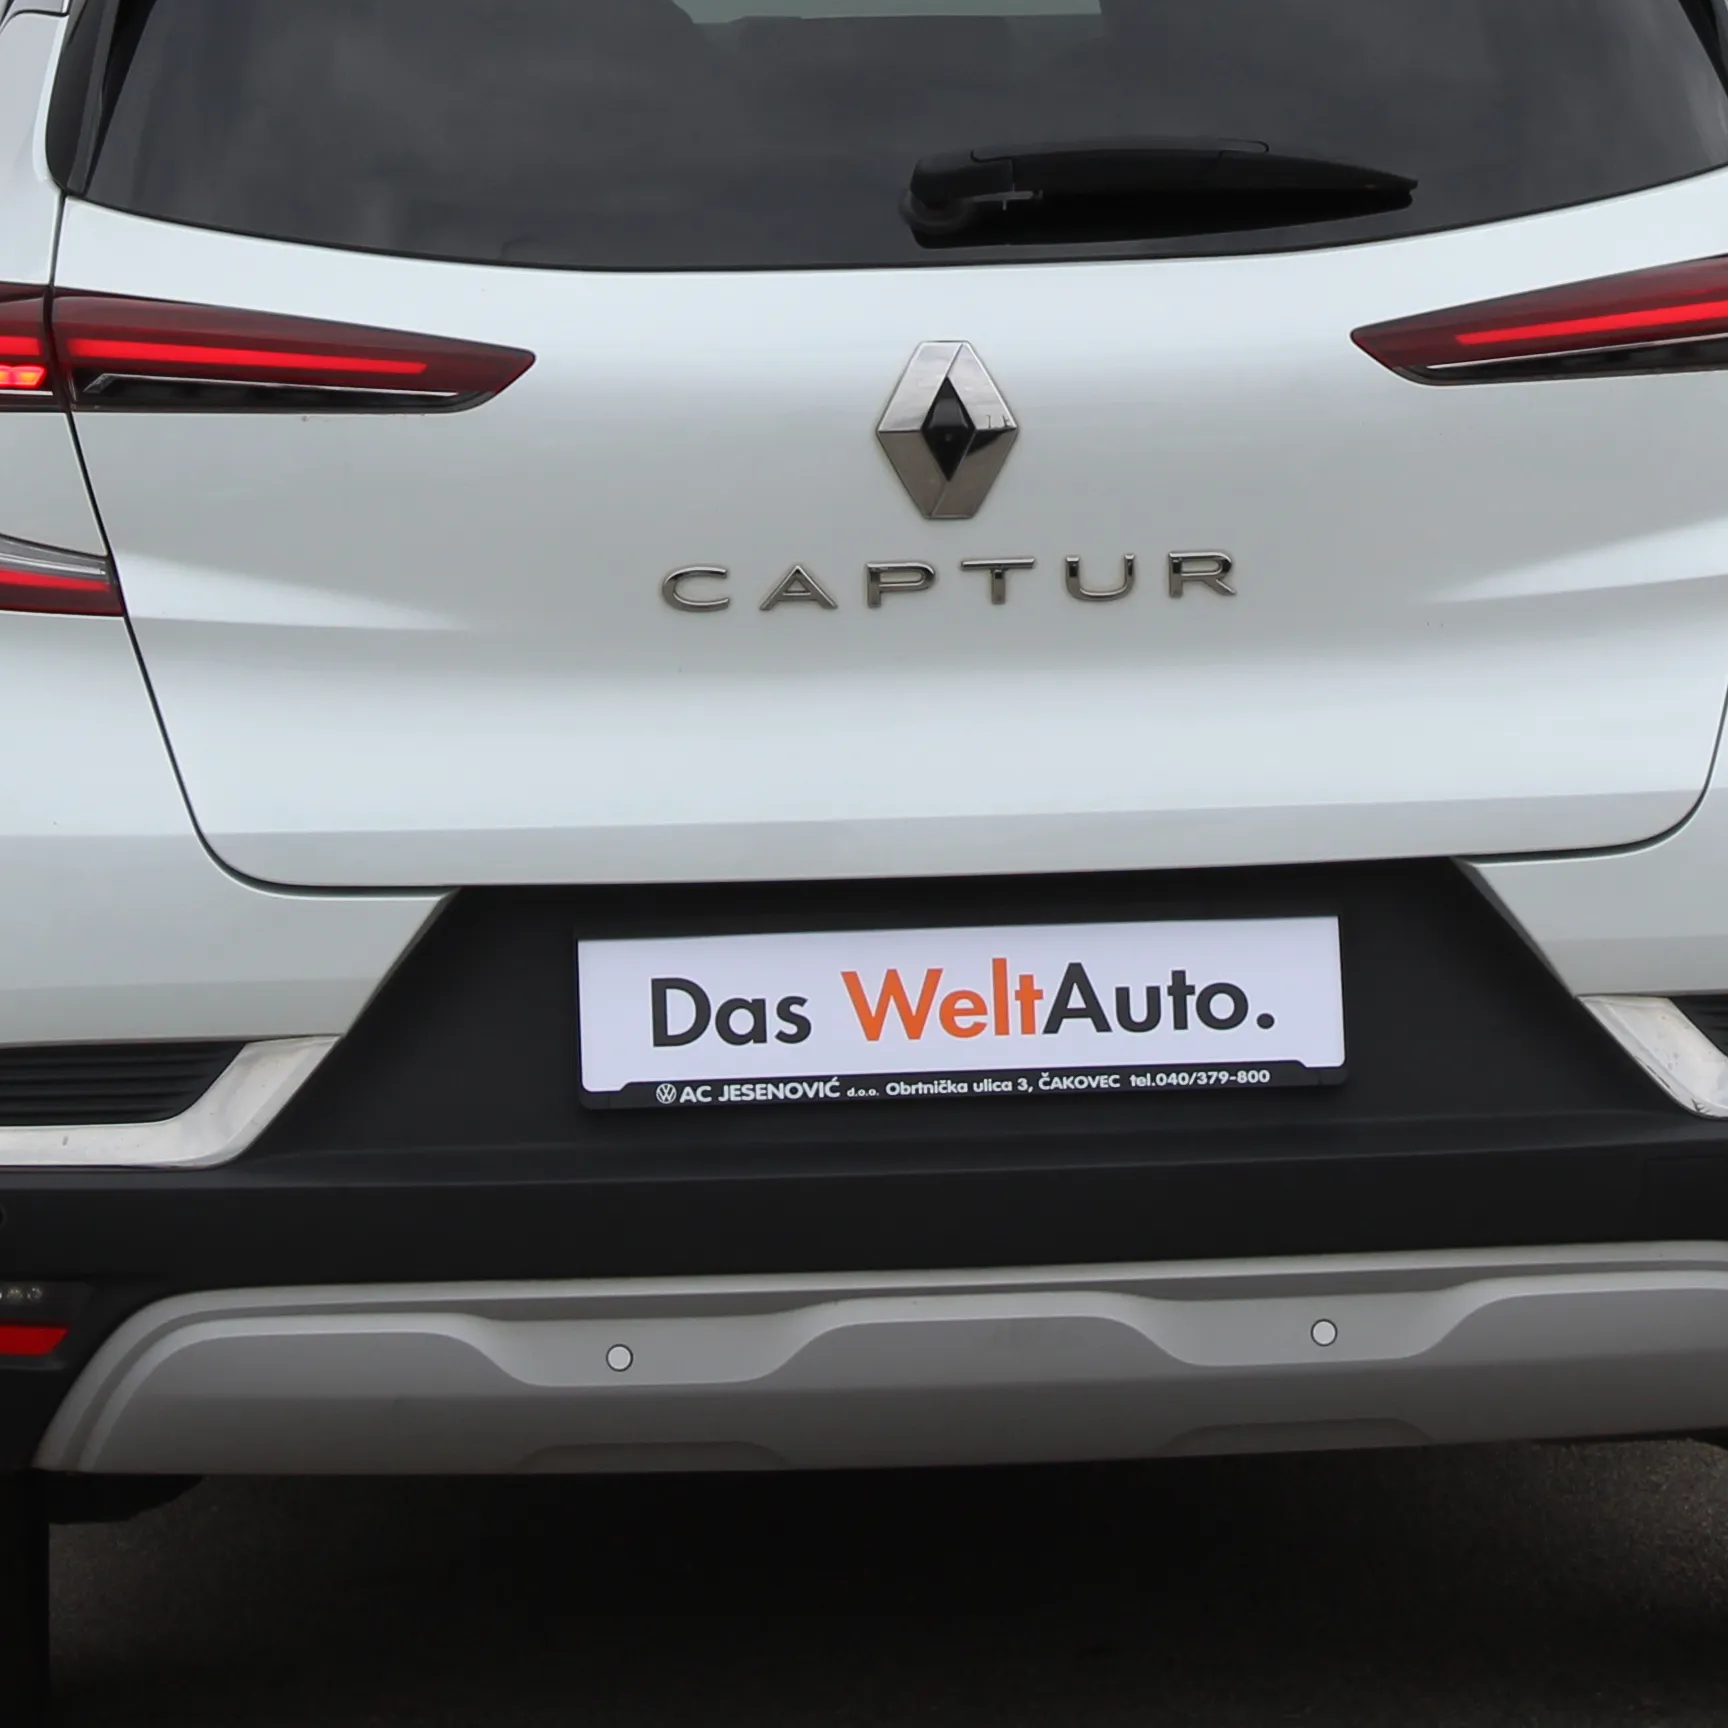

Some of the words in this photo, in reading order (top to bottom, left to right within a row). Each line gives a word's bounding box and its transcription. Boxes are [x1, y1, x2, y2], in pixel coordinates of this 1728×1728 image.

[659, 550, 1238, 615] CAPTUR
[650, 976, 813, 1049] Das
[841, 957, 1276, 1042] WeltAuto.
[679, 1085, 712, 1104] AC
[717, 1076, 841, 1103] JESENOVIĆ
[846, 1086, 880, 1098] d.o.o.
[885, 1079, 969, 1097] Obrtnička
[973, 1077, 1013, 1093] ulica
[1016, 1077, 1034, 1094] 3,
[1038, 1071, 1122, 1091] ČAKOVEC
[1128, 1068, 1271, 1088] tel.040/379-800
